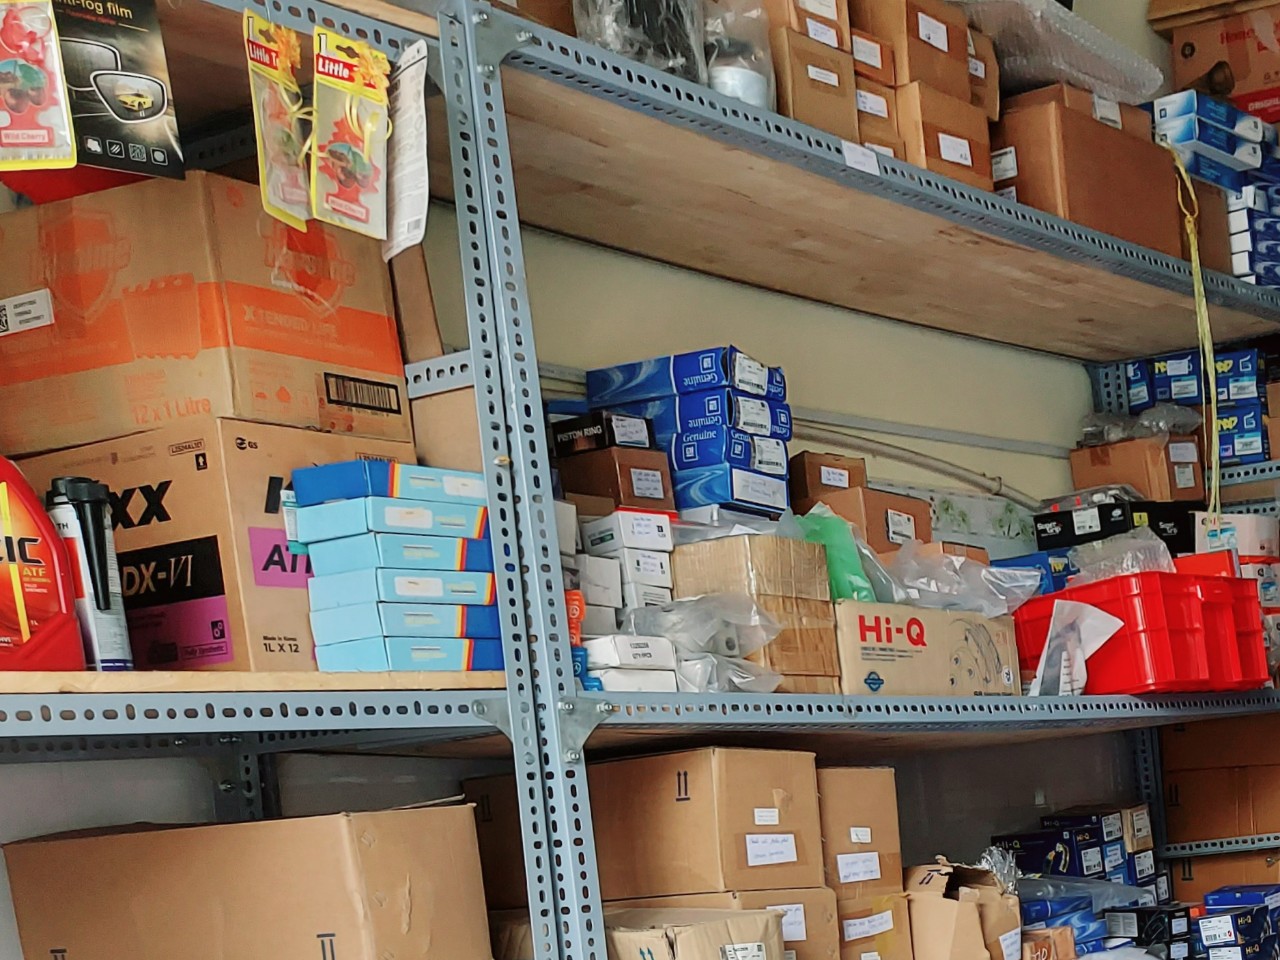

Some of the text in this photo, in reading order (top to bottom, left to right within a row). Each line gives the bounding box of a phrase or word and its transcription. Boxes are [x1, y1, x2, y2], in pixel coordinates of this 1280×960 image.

[108, 3, 134, 20] film
[249, 44, 270, 64] Little
[318, 57, 351, 79] Little
[21, 132, 47, 142] Cherry
[683, 372, 718, 387] Genuine
[688, 415, 722, 428] Genuine
[557, 424, 603, 443] PISTON RING
[682, 429, 717, 443] Genuine
[0, 536, 46, 566] IC
[23, 567, 46, 577] ATF
[122, 554, 193, 597] DX-VI
[858, 614, 928, 647] Hi-Q
[263, 642, 300, 653] 1L X 12
[1238, 915, 1252, 926] Hi-Q
[1246, 944, 1260, 955] Hi-Q
